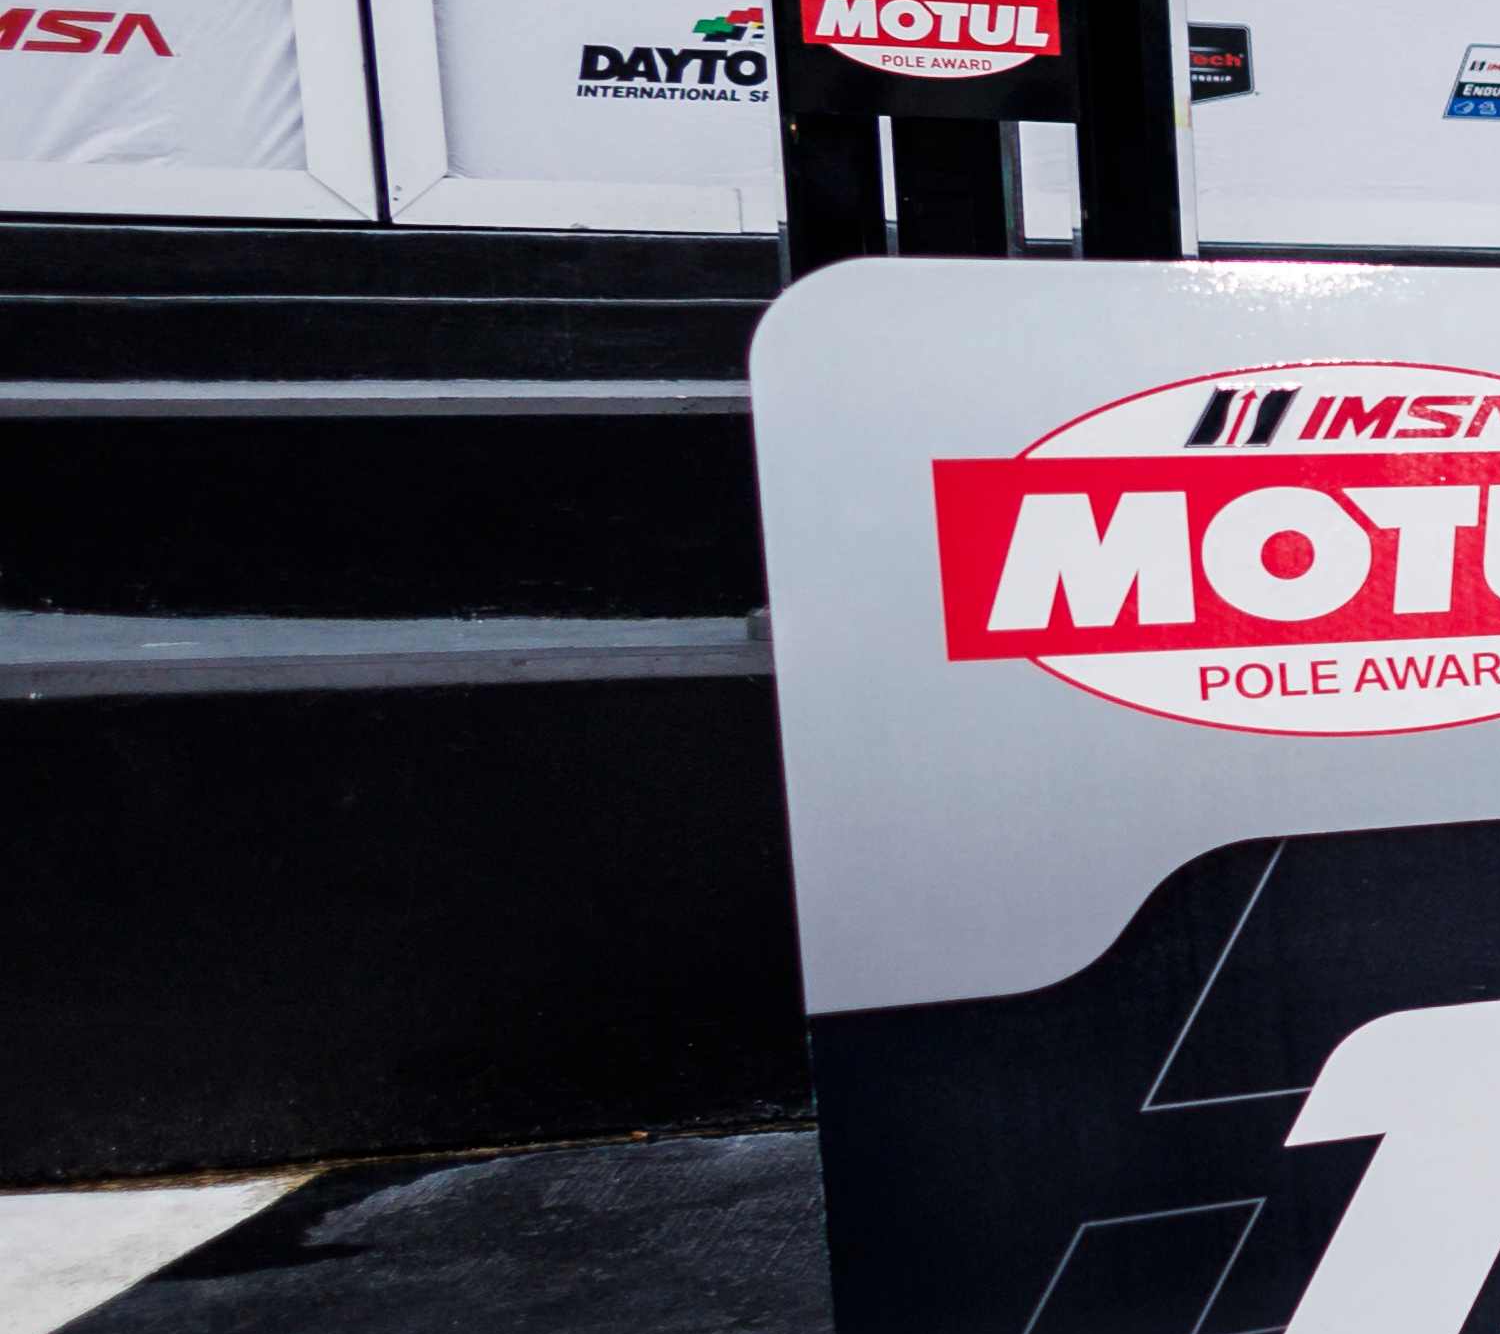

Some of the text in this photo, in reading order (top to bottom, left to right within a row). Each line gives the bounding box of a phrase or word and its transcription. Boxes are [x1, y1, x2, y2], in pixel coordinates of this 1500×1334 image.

[0, 9, 173, 58] MSA
[578, 44, 768, 87] DAYTO
[881, 54, 993, 72] POLE AWARD
[576, 84, 741, 102] INTERNATIONAL
[1197, 657, 1341, 702] POLE
